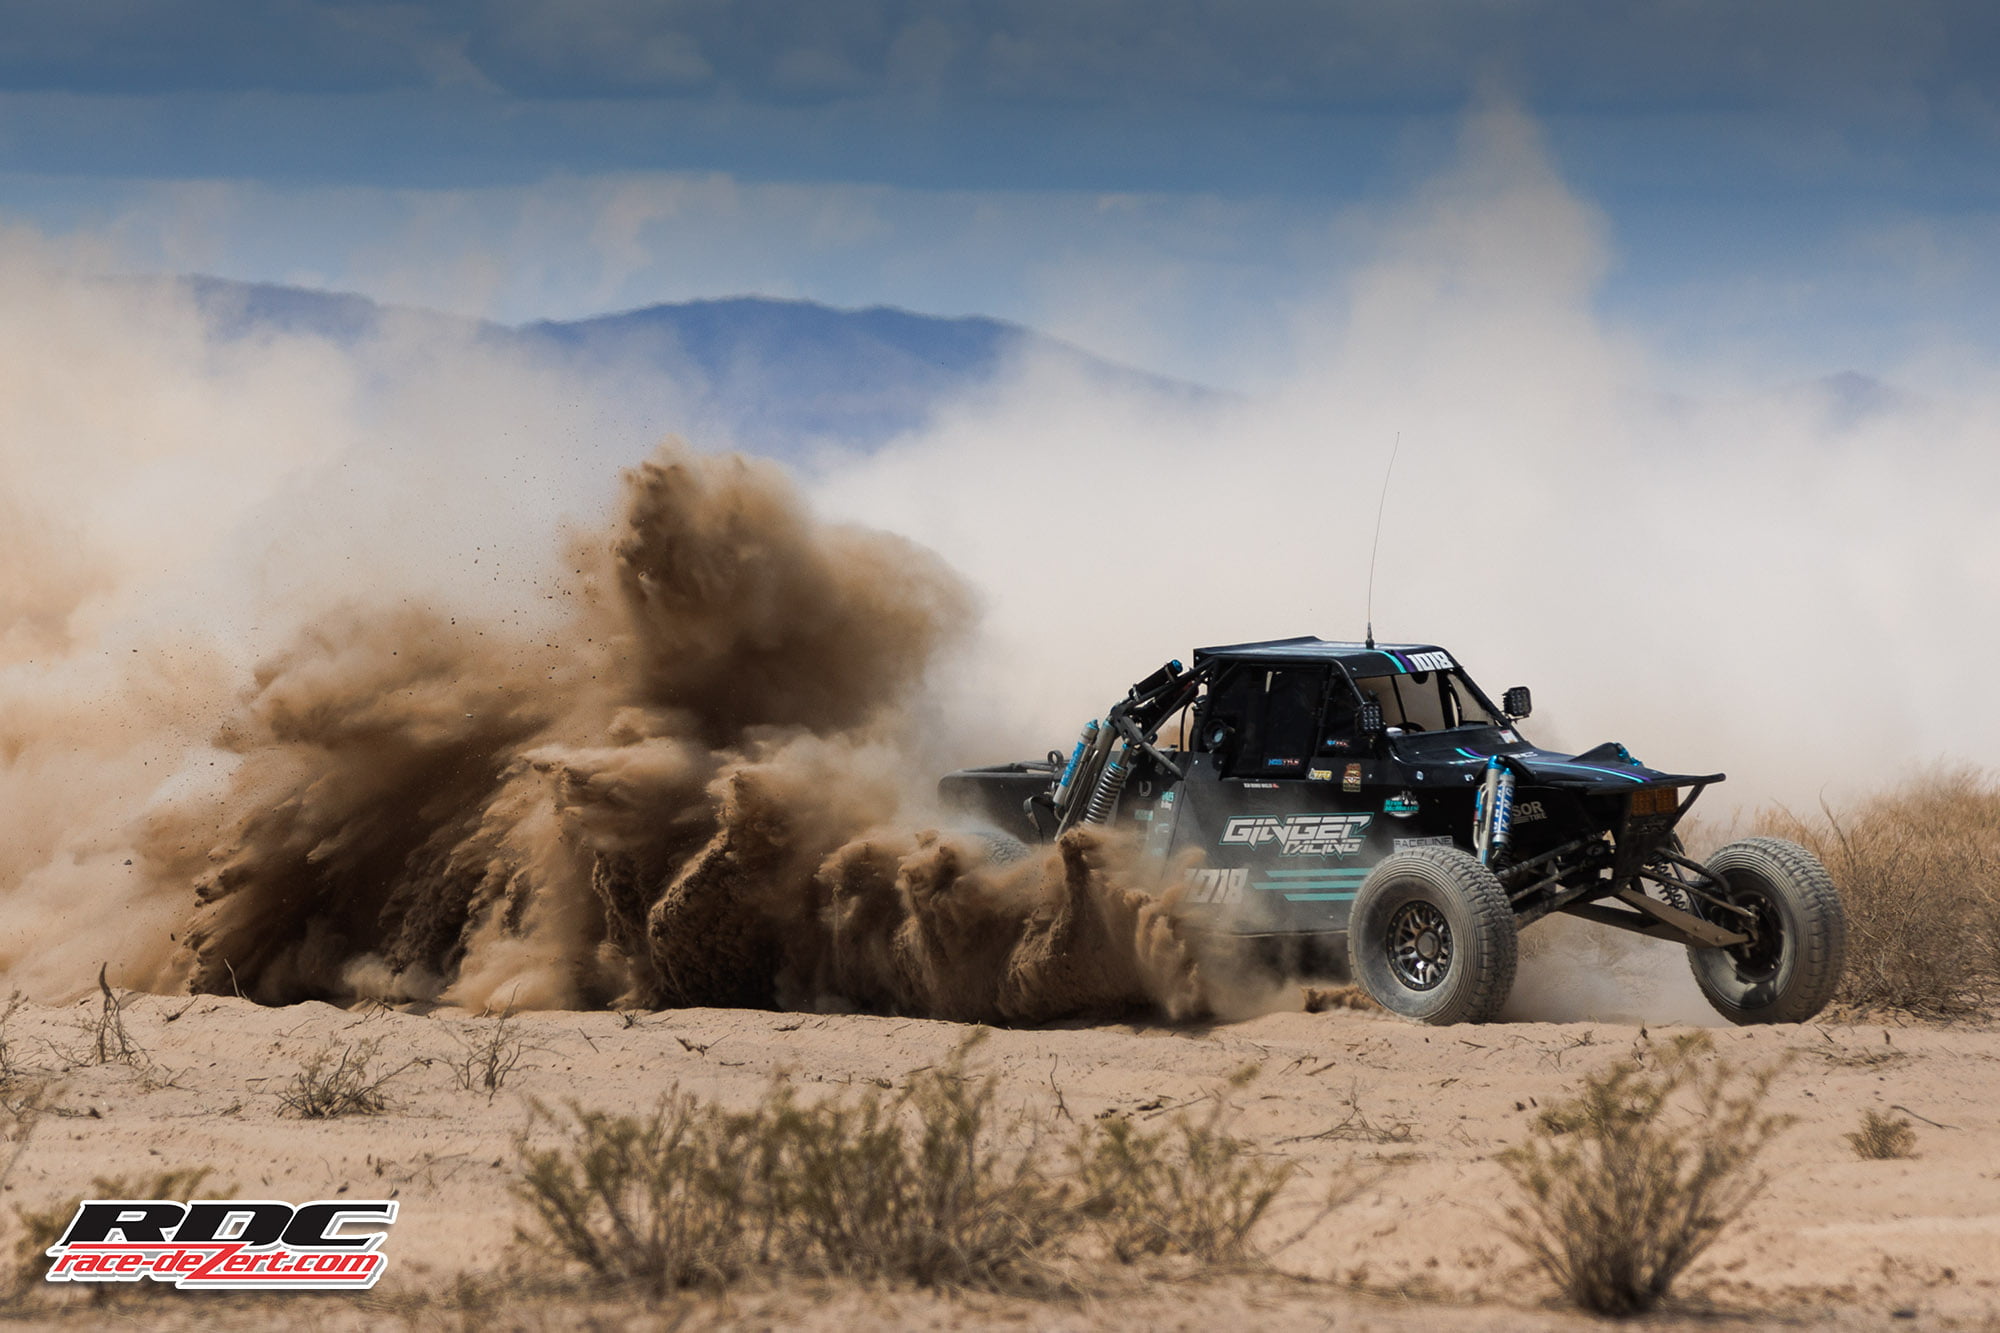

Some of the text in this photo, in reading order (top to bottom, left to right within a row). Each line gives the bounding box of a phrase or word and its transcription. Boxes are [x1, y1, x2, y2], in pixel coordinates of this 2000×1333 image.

[1405, 651, 1454, 671] 1018
[1511, 801, 1545, 818] SOR
[1282, 838, 1363, 857] RACING
[1394, 836, 1453, 848] RACELINE
